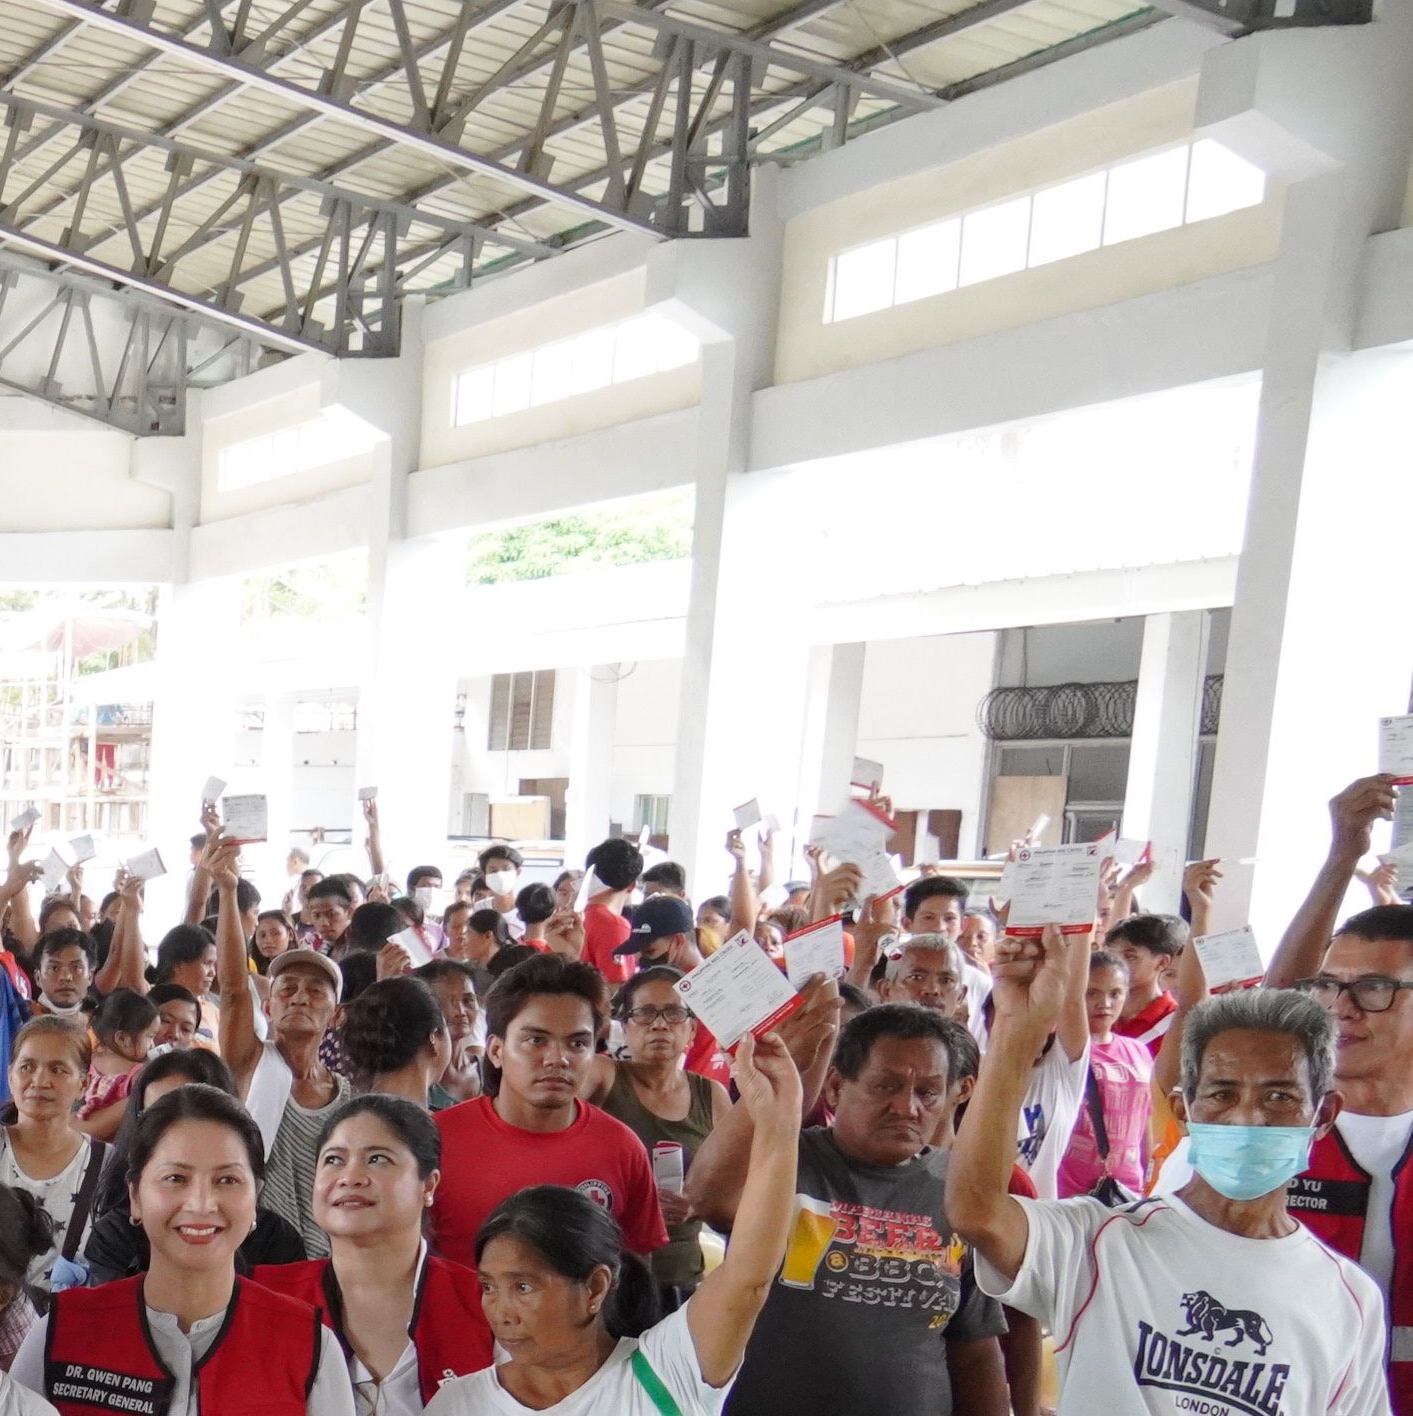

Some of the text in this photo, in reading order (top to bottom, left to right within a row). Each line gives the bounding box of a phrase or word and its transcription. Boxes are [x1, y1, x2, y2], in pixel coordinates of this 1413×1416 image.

[1302, 1179, 1322, 1192] YU
[1285, 1195, 1328, 1210] RECTOR
[830, 1211, 943, 1253] BEER
[65, 1365, 153, 1394] DR. GWEN PANG
[52, 1382, 154, 1415] SECRETARY GENERAL
